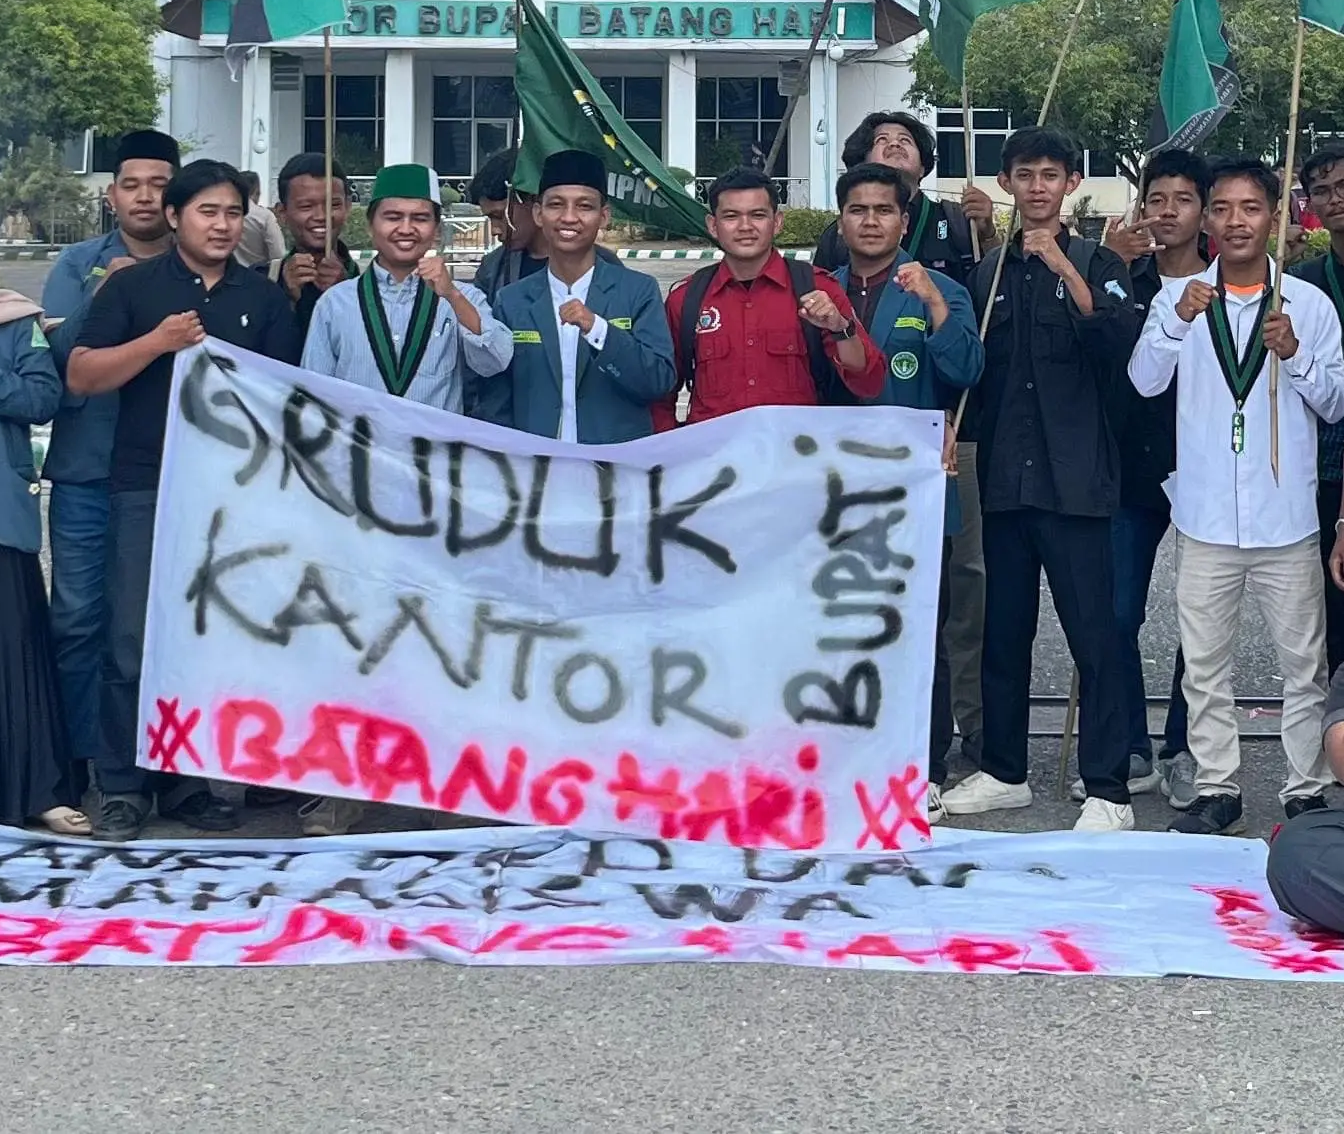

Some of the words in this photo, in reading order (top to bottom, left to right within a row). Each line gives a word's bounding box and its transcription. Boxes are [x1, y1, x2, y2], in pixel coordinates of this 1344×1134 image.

[418, 4, 558, 35] BUPAI
[578, 5, 734, 36] BATANG
[752, 6, 847, 36] HARI
[185, 506, 749, 741] KANTOR
